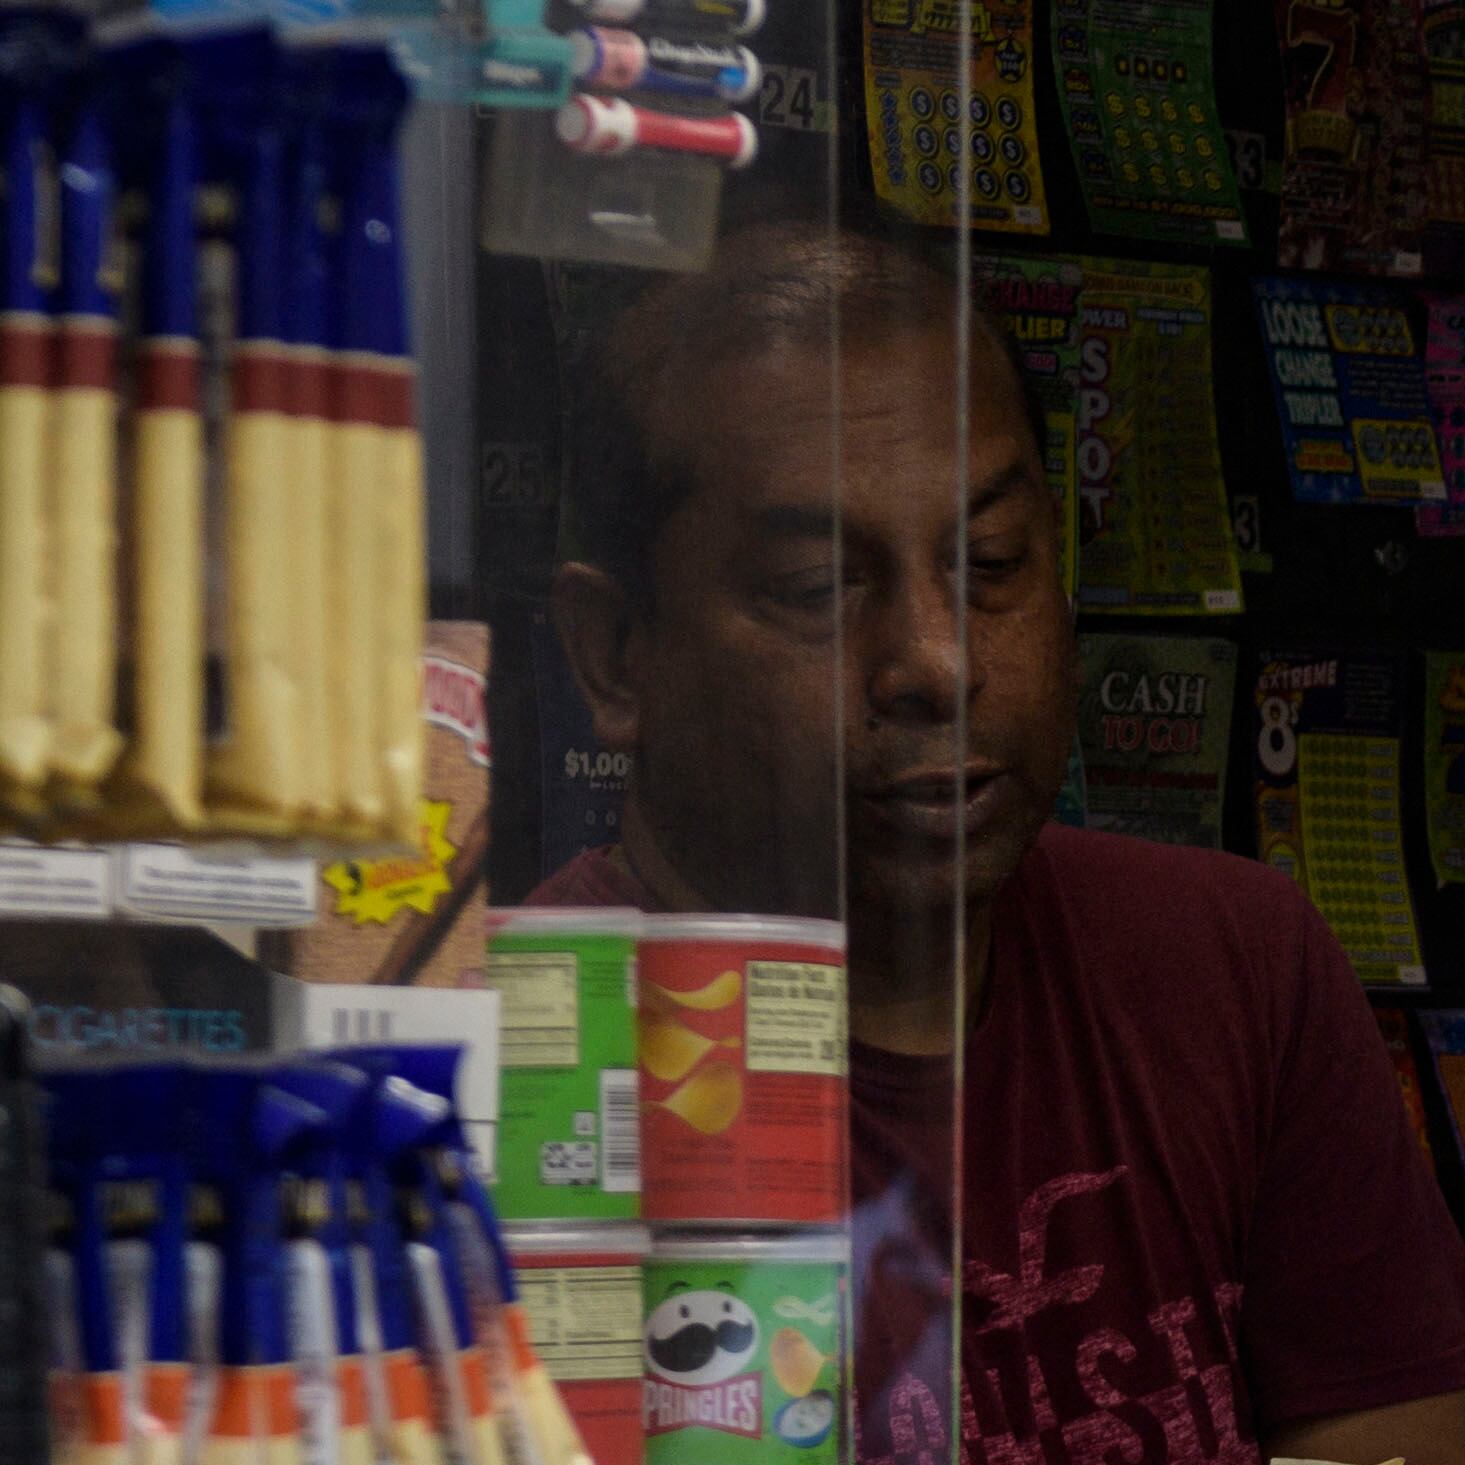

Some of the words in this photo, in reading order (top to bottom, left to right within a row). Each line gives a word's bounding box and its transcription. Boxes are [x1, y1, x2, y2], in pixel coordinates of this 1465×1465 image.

[761, 74, 815, 126] 24
[1101, 670, 1209, 715] CASH
[643, 1378, 762, 1431] PRINGLES
